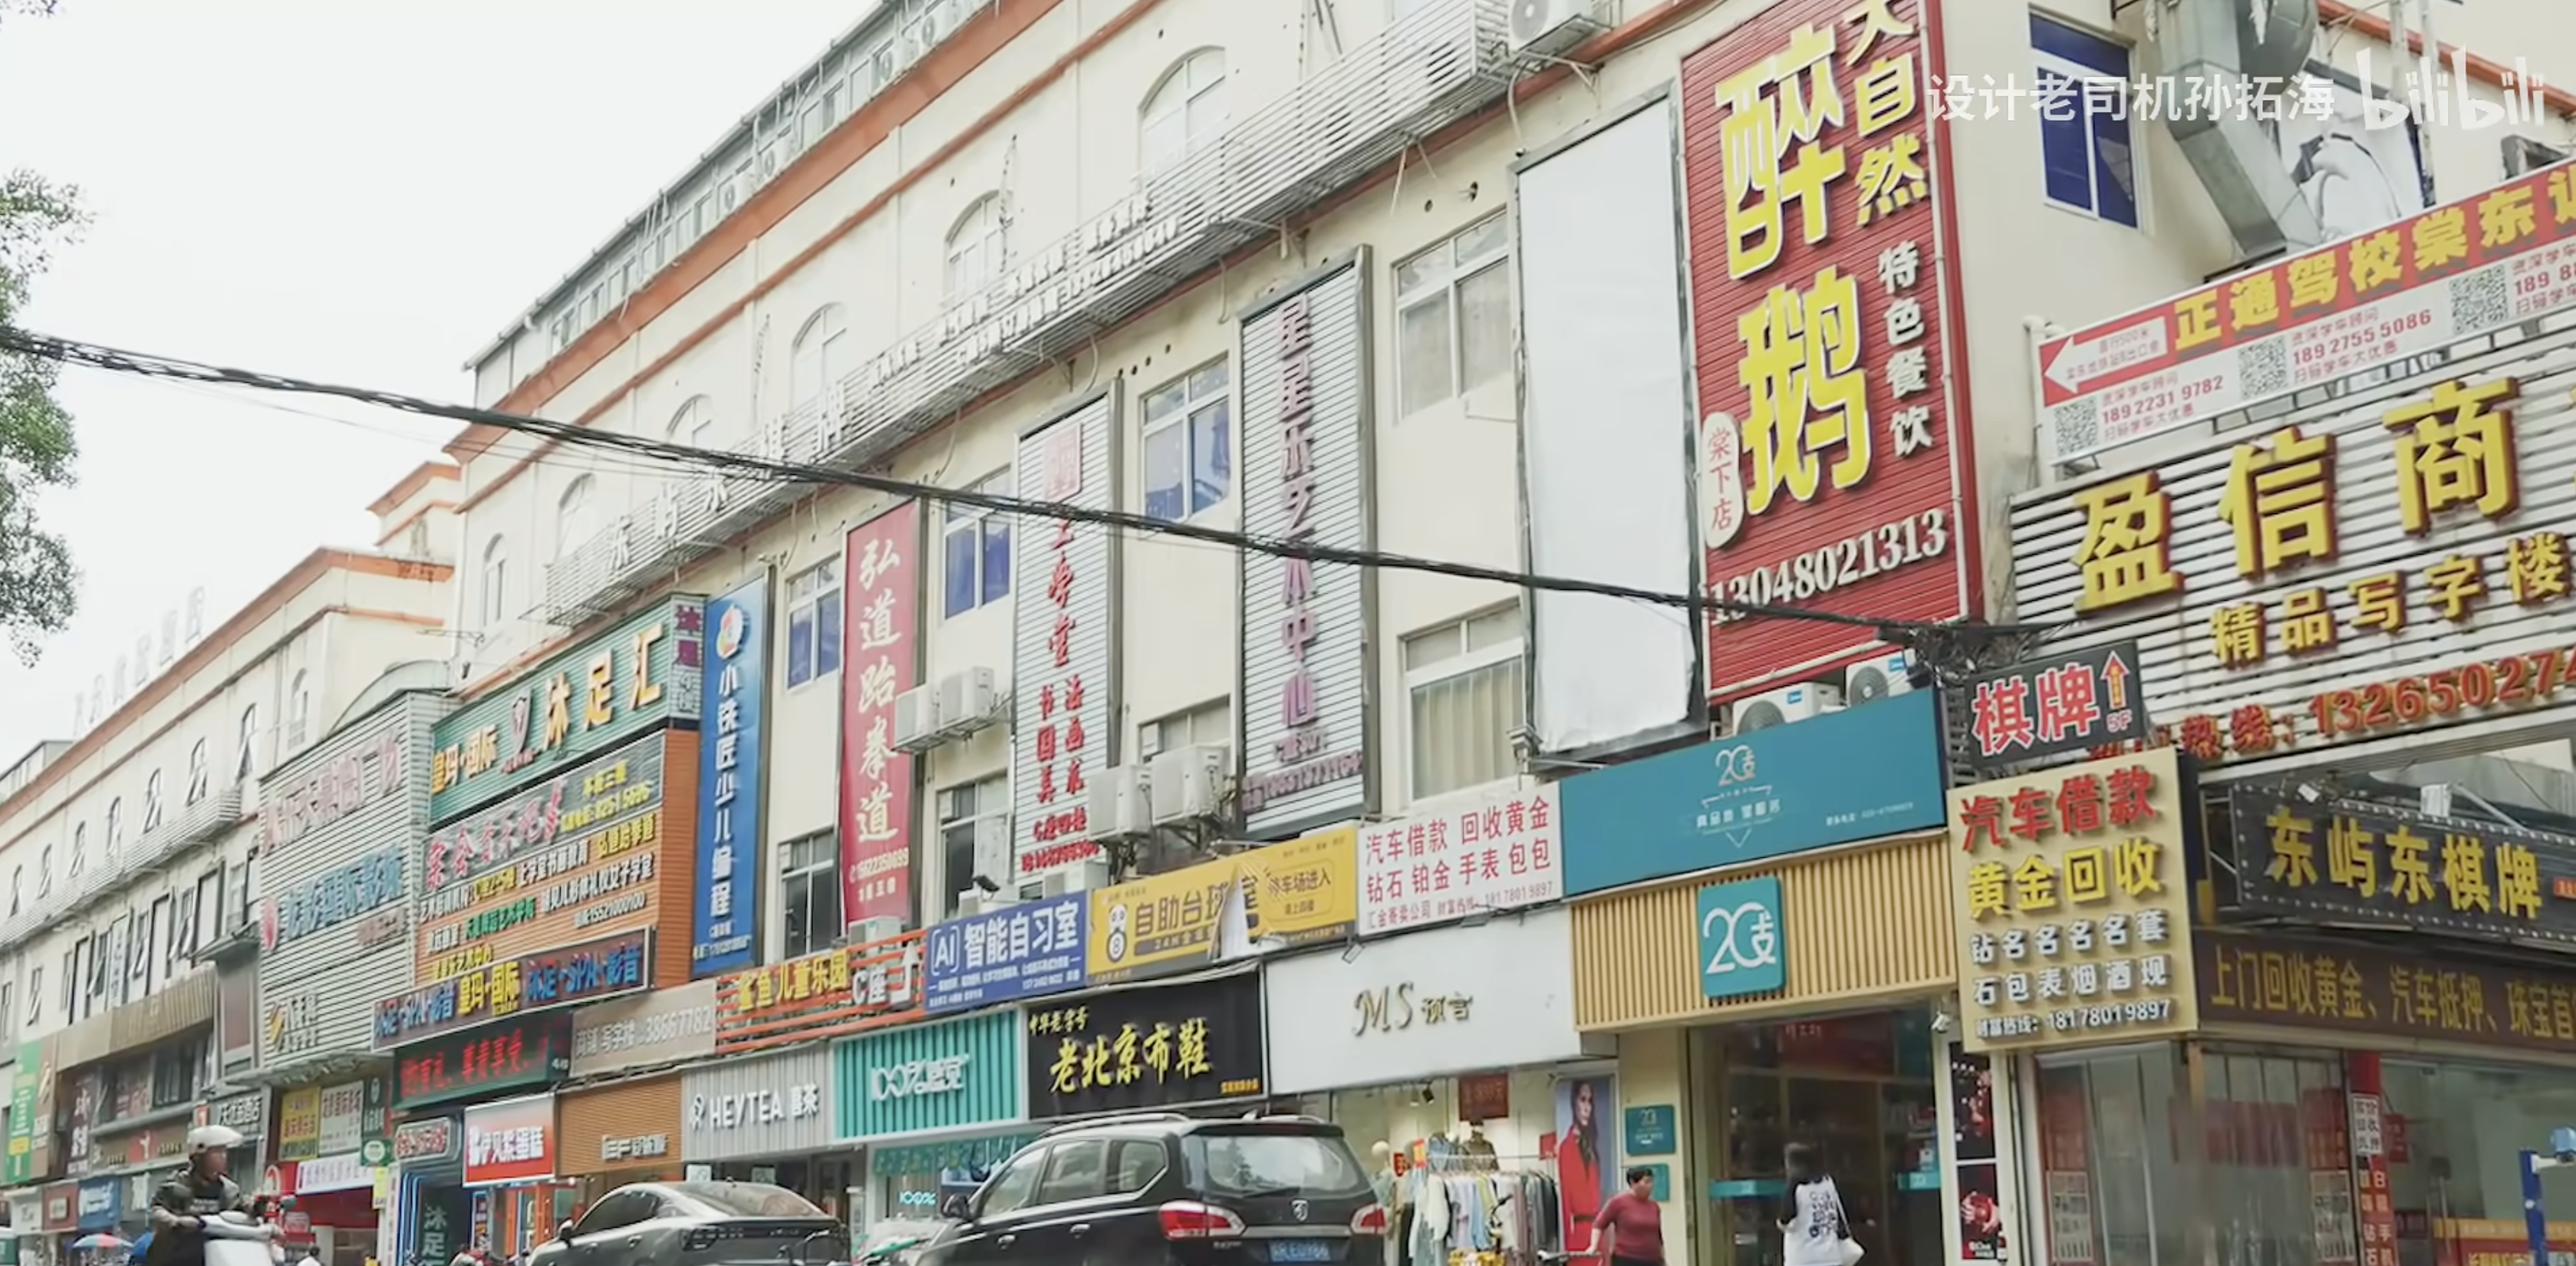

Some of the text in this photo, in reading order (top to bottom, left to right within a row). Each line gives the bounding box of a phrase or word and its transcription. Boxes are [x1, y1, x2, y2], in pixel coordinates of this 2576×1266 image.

[1715, 21, 1871, 515] 醉鹅
[2515, 272, 2550, 295] 189
[1878, 239, 1933, 458] 特色餐饮
[2294, 310, 2431, 364] 189 2755 5086
[2103, 376, 2223, 424] 189 2231 9782
[1708, 428, 1733, 531] 棠下店
[2071, 376, 2576, 614] 盈信商
[1710, 507, 1949, 625] 13048021313
[2211, 530, 2571, 670] 精品写字楼
[1972, 661, 2100, 757] 棋牌
[2107, 709, 2133, 733] 5F
[1365, 818, 1448, 867] 汽车借款
[1461, 796, 1550, 845] 回收黄金
[1961, 765, 2156, 852] 汽车借款
[1366, 838, 1551, 904] 钻石 铂金 手表 包包
[1968, 836, 2163, 920] 黄金回收
[2265, 806, 2544, 920] 东屿东棋牌
[964, 901, 1079, 970] 智能自习室
[852, 967, 887, 1005] C座
[1352, 982, 1414, 1037] MS
[2211, 943, 2576, 1040] 上门回收黄金、汽车抵押、珠宝首
[1049, 1017, 1214, 1094] 老北京布鞋
[710, 1086, 786, 1129] HEYTEA
[899, 1191, 937, 1205] 100%
[423, 1207, 447, 1266] 沐足
